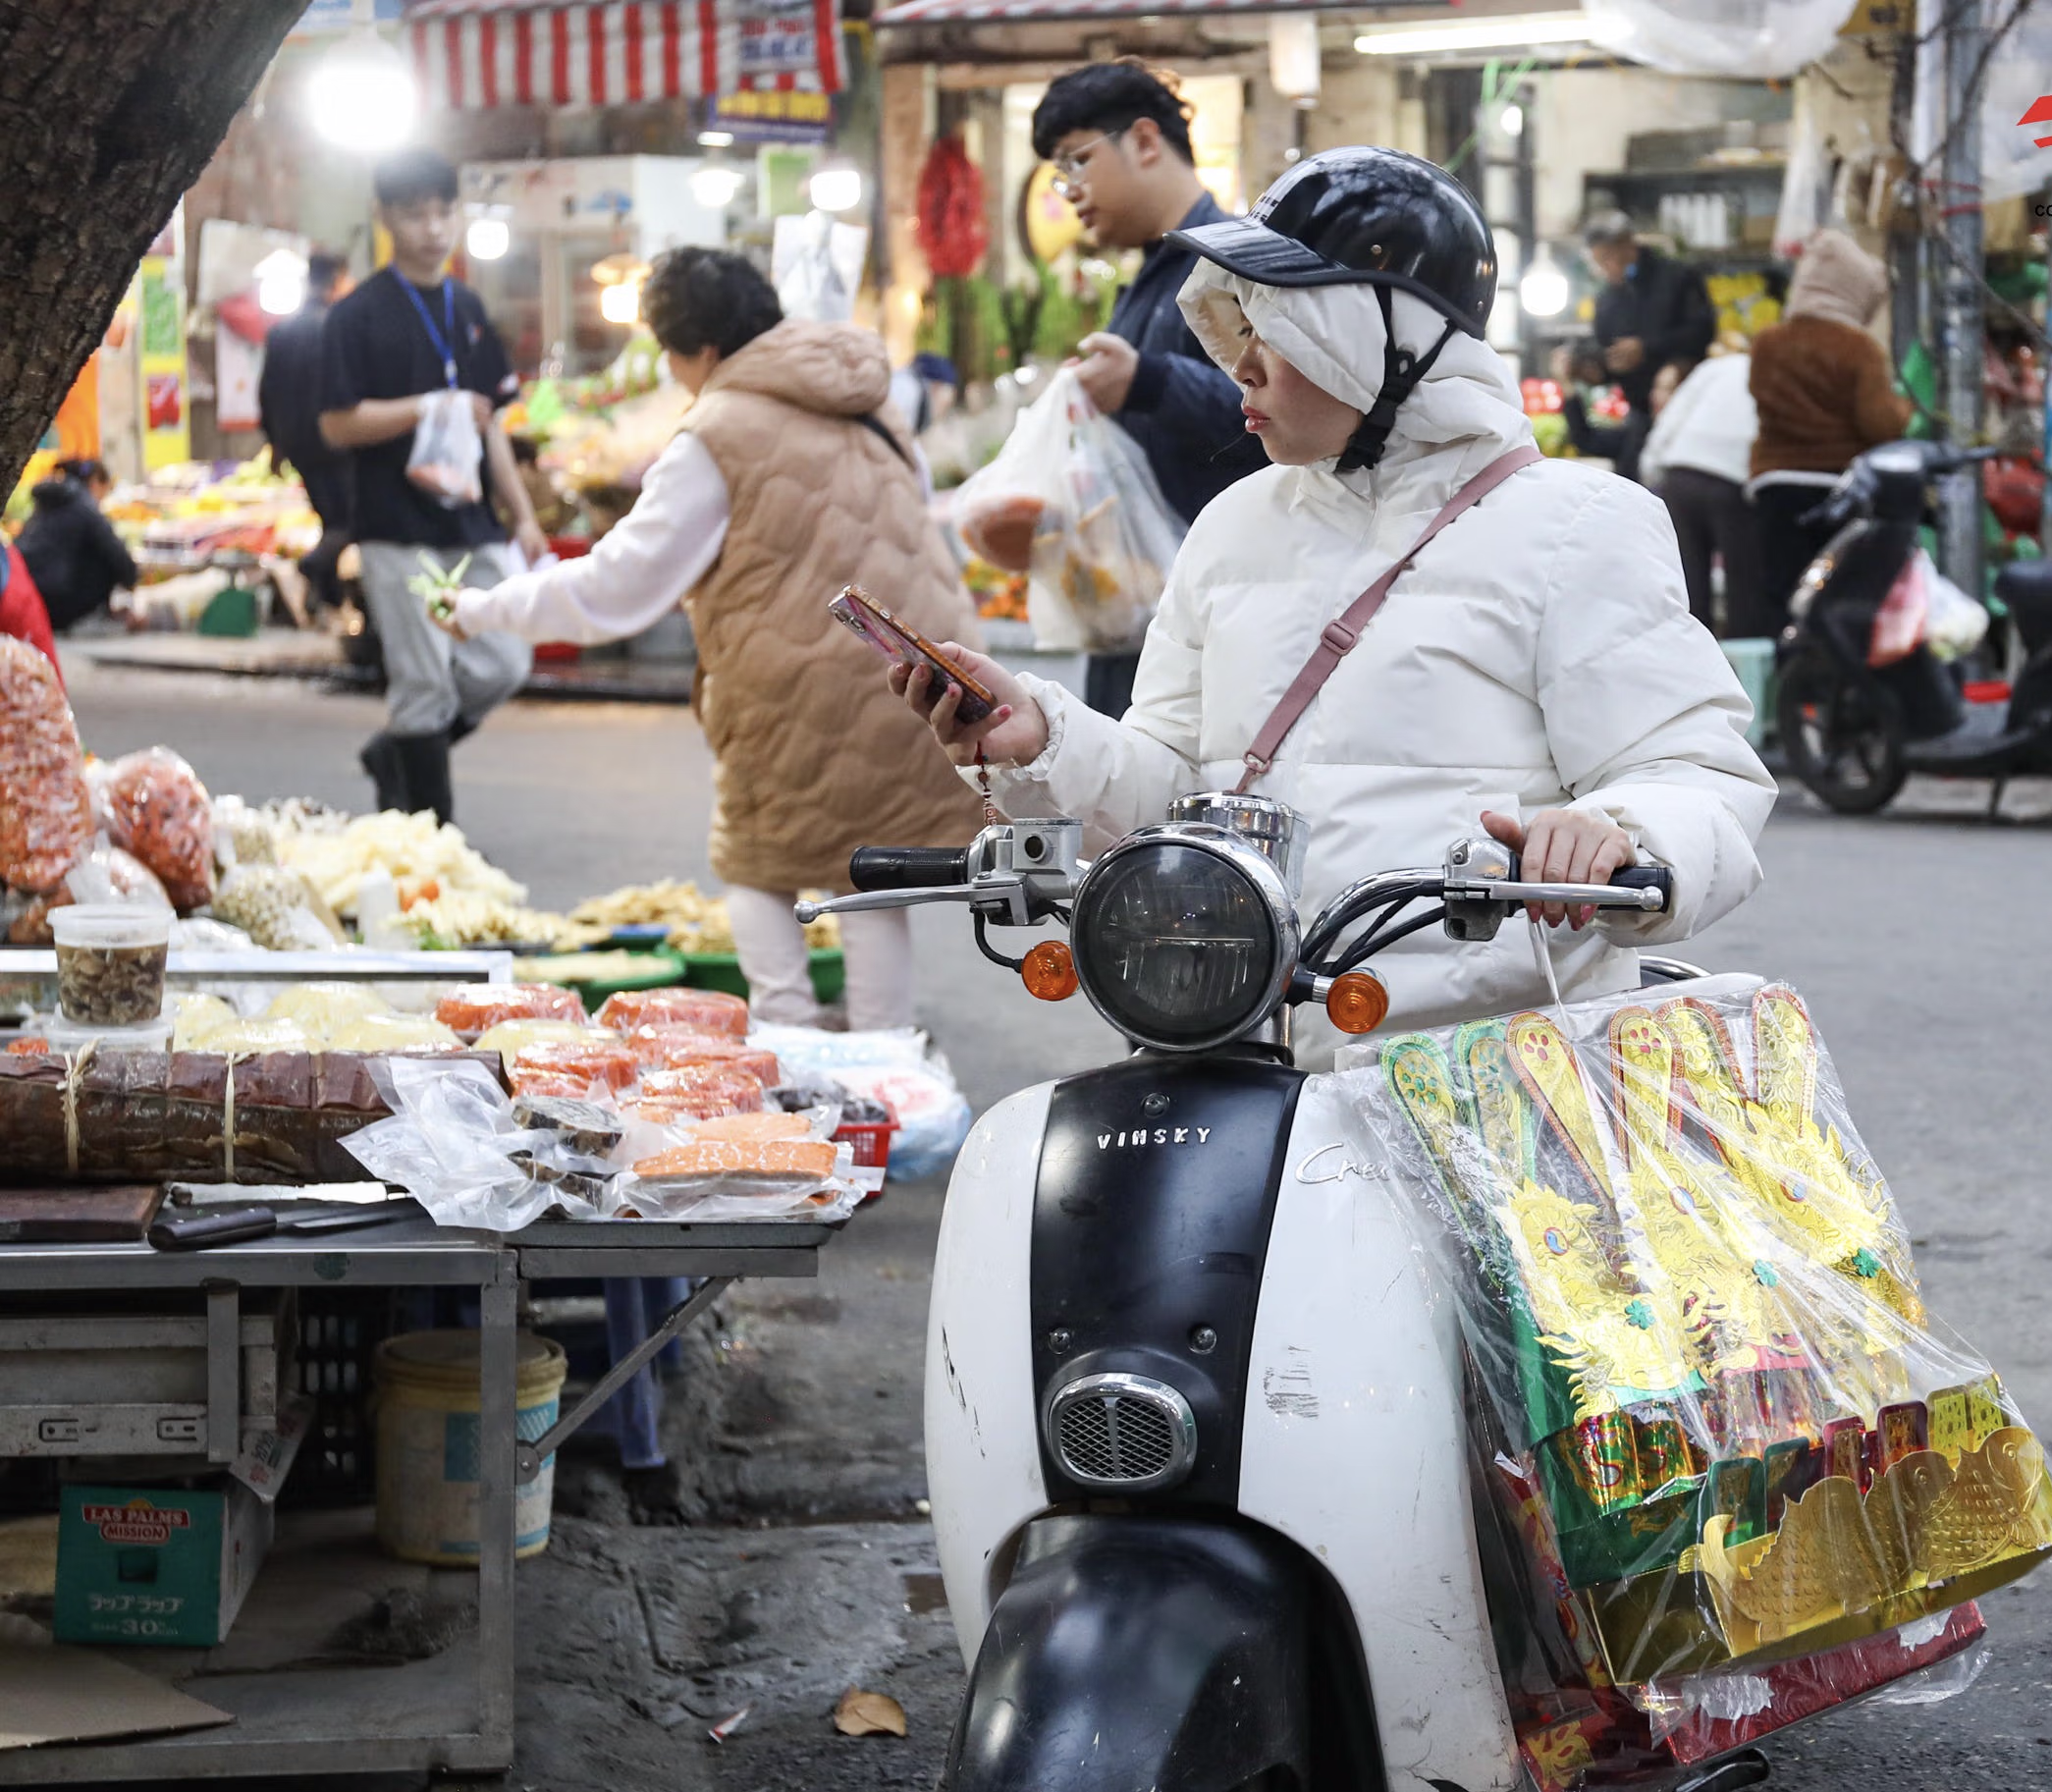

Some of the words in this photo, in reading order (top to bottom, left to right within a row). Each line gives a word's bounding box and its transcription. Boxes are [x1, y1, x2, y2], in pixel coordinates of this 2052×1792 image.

[1097, 1126, 1211, 1150] VINSKY
[90, 1508, 123, 1522] LAS
[127, 1511, 183, 1525] PALMS
[107, 1524, 163, 1539] MISSION
